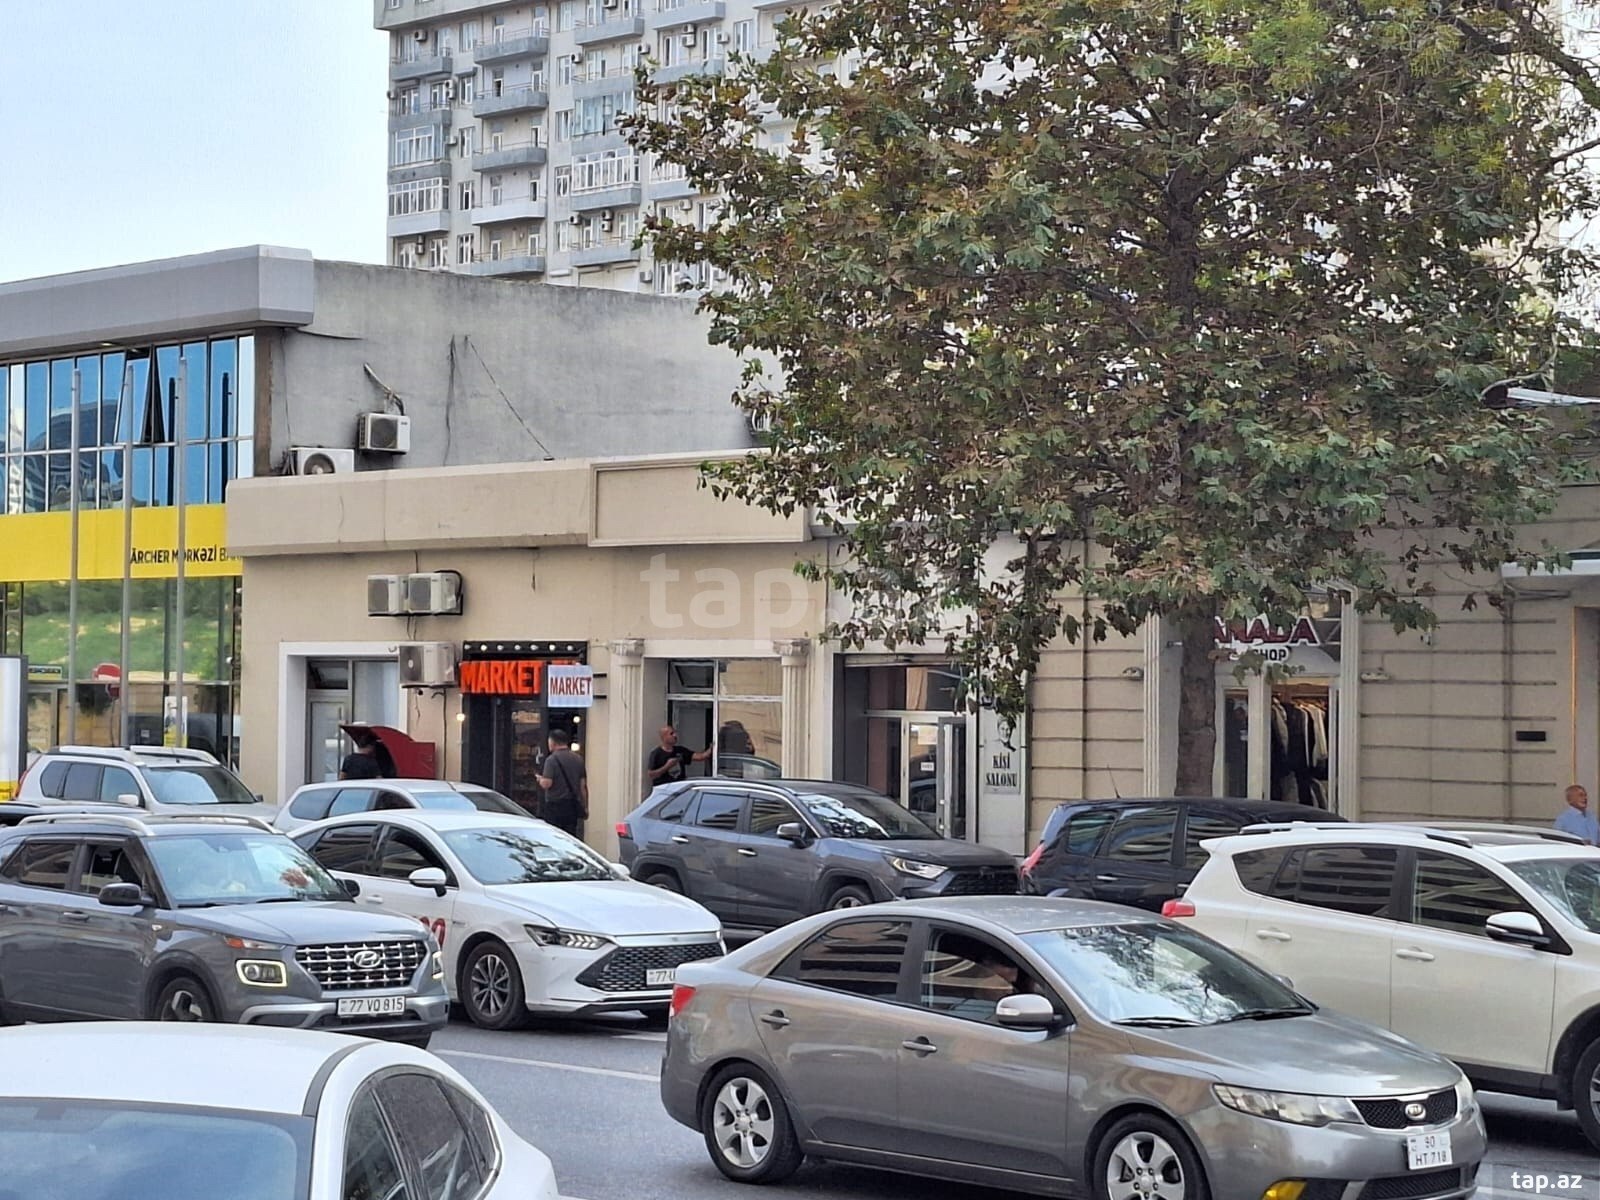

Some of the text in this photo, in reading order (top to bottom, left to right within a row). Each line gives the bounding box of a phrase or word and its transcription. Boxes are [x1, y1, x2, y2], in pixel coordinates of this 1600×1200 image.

[130, 548, 169, 563] ÄRCHER
[460, 660, 544, 694] MARKET
[550, 676, 592, 695] MARKET
[350, 999, 363, 1012] 77
[383, 998, 403, 1011] 815
